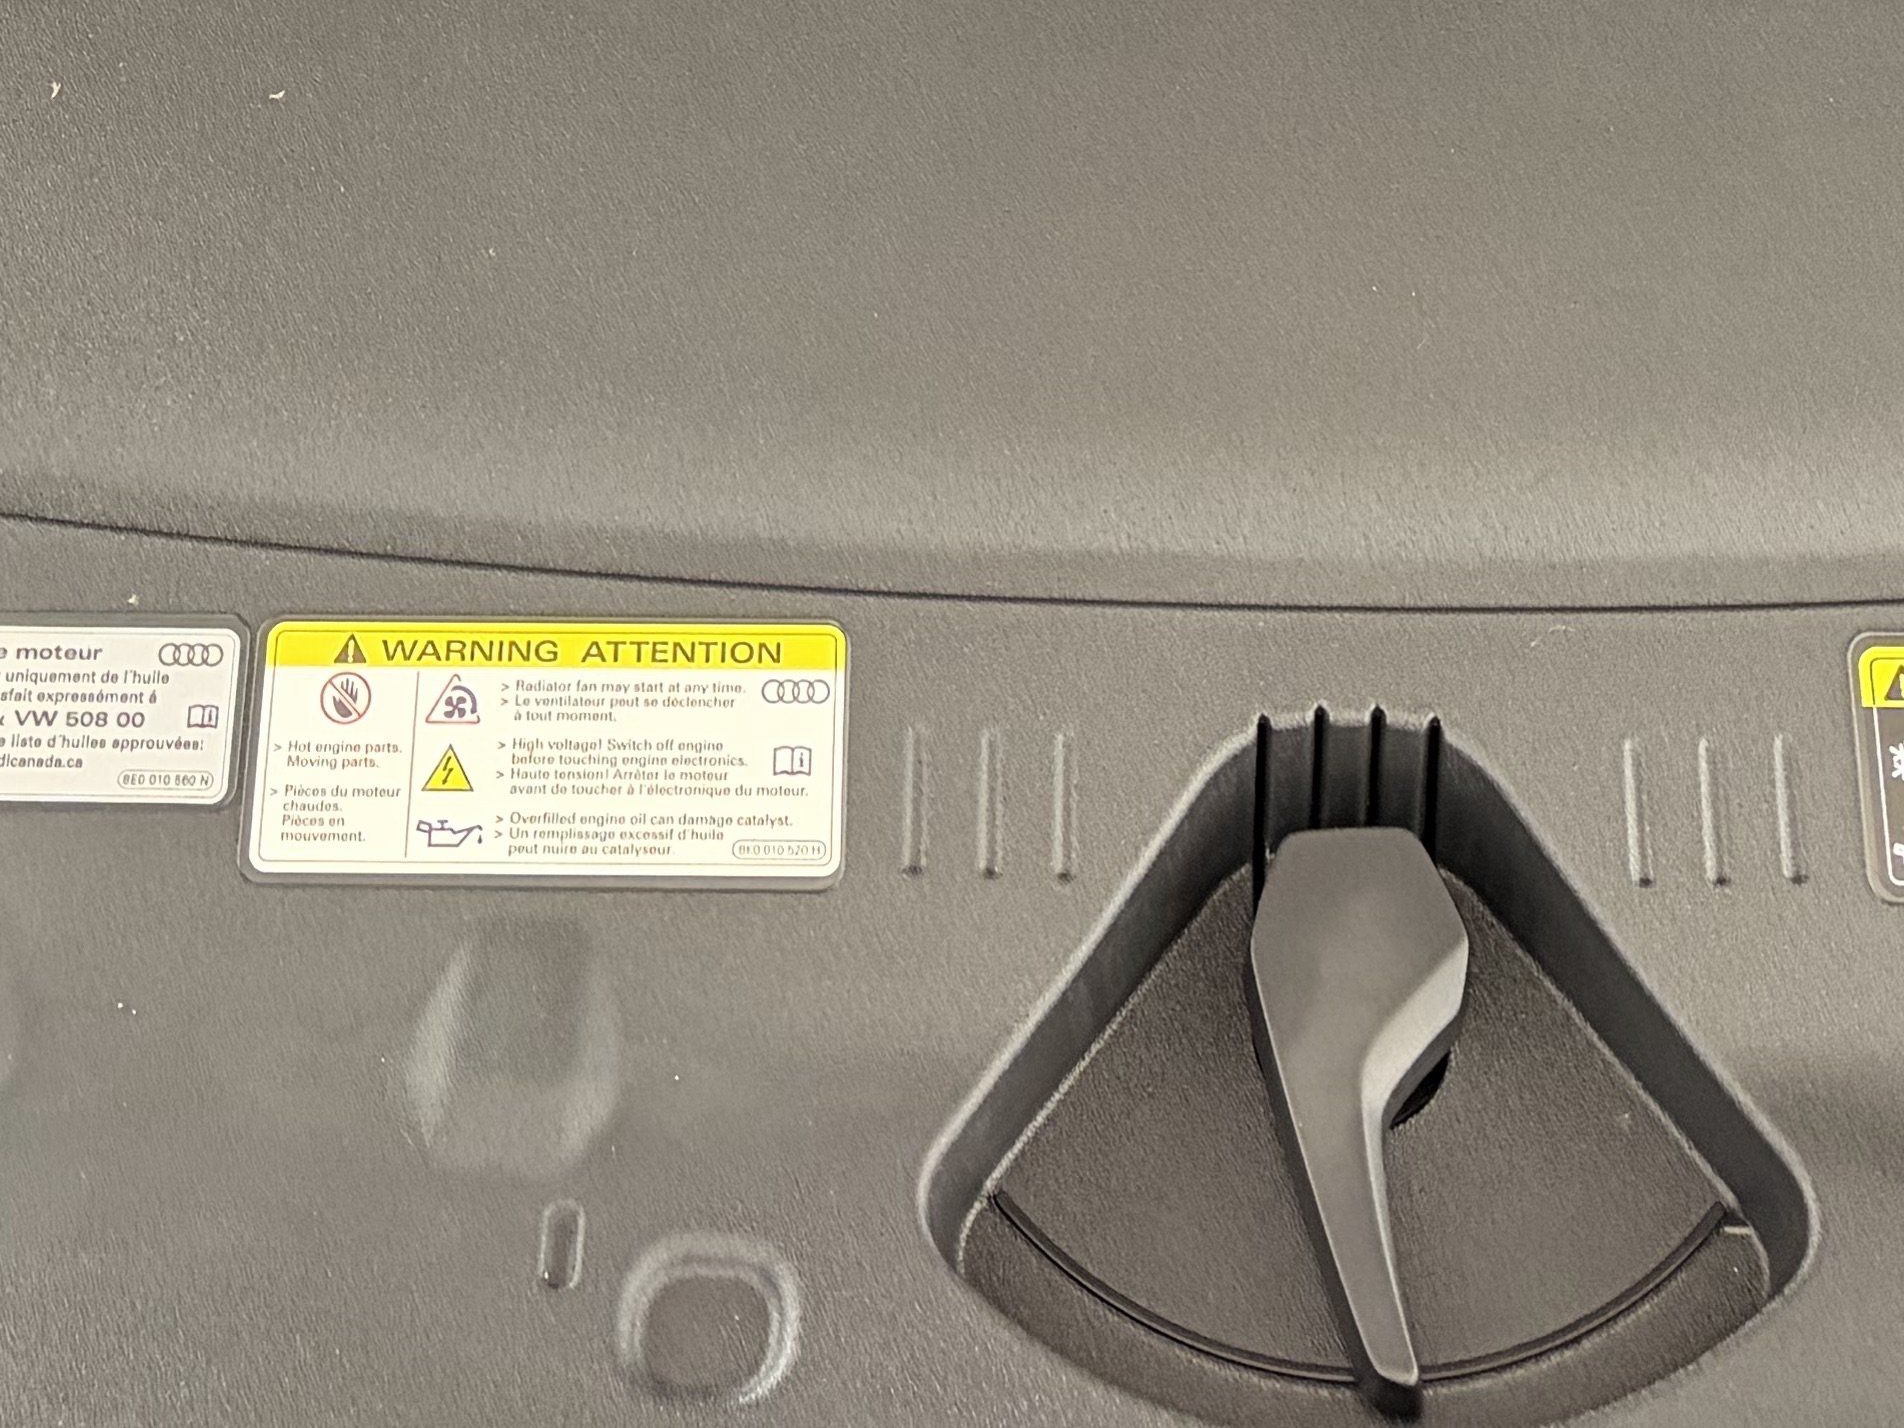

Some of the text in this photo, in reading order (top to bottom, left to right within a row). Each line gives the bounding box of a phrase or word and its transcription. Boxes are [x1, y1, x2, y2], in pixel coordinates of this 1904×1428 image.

[15, 645, 103, 661] moteur
[382, 638, 782, 665] WARNING ATTENTION
[5, 668, 96, 685] uniquement
[100, 669, 119, 685] de
[515, 679, 746, 695] Radiator fan may start at any time.
[36, 688, 144, 706] expressément
[515, 694, 531, 707] Le
[534, 695, 605, 708] ventilateur
[609, 696, 639, 710] peut
[643, 698, 659, 708] se
[14, 709, 59, 727] VW
[65, 711, 109, 728] 508
[116, 711, 146, 729] 00
[526, 710, 552, 722] tout
[556, 711, 617, 722] moment.
[11, 733, 42, 749] liste
[111, 735, 204, 753] approuvées:
[288, 739, 402, 756] Hot engine parts.
[512, 737, 724, 753] High voltage! Switch off engine
[287, 754, 379, 770] Moving parts.
[511, 752, 748, 769] before touching engine electronics.
[149, 774, 171, 786] 010
[510, 768, 550, 780] Haute
[664, 769, 676, 781] le
[679, 770, 728, 782] moteur
[284, 783, 401, 798] Pièces du moteur
[509, 784, 547, 795] avant
[550, 783, 568, 795] de
[571, 783, 622, 796] toucher
[734, 784, 752, 797] du
[756, 785, 808, 797] moteur.
[282, 799, 342, 812] chaudes.
[282, 813, 345, 827] Pièces en
[509, 811, 793, 830] Overfilled engine oil can damage catalyst.
[280, 831, 366, 842] mouvement.
[509, 827, 529, 840] Un
[533, 827, 616, 843] remplissage
[619, 828, 674, 841] excessif
[508, 843, 538, 857] peut
[542, 842, 577, 855] nuire
[581, 845, 598, 855] au
